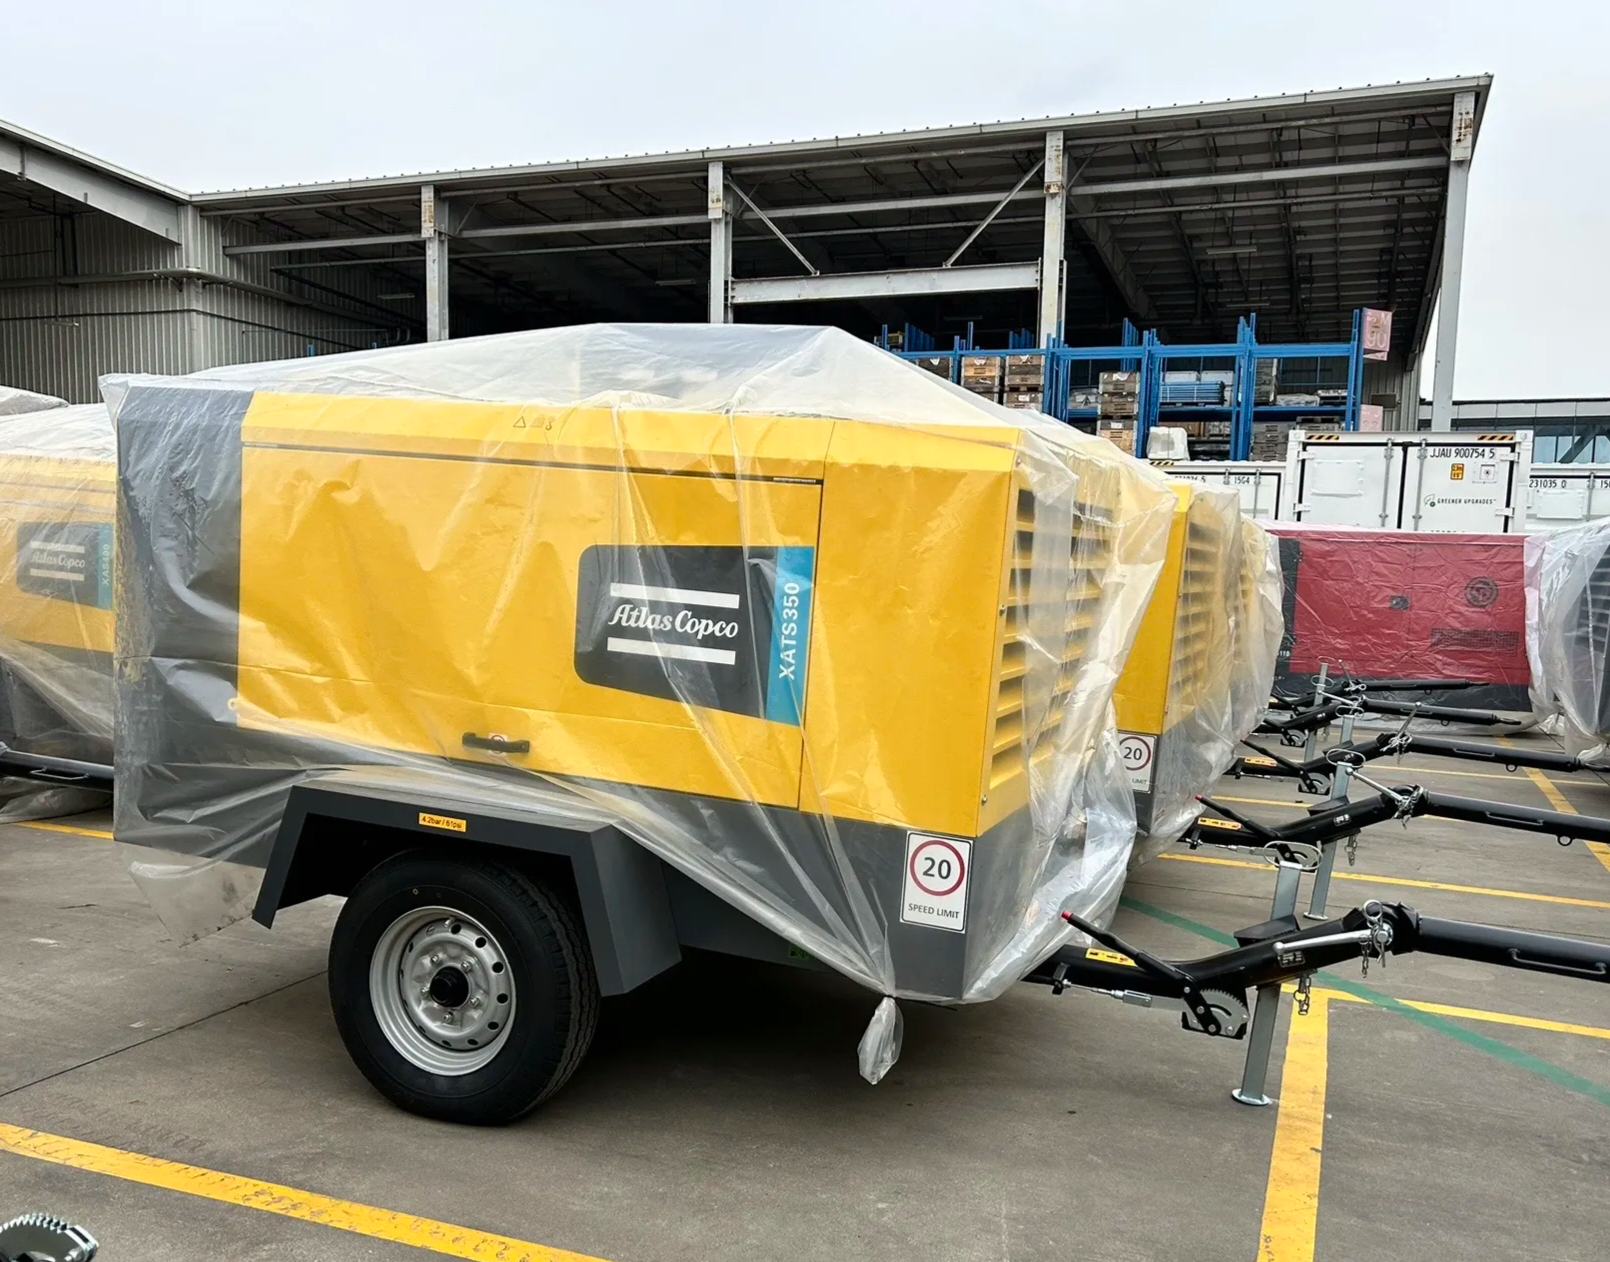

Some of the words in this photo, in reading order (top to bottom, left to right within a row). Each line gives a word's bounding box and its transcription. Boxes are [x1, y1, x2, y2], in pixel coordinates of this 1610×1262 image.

[1430, 448, 1451, 458] JJAU
[1454, 448, 1485, 458] 900754
[1489, 448, 1495, 458] 5
[1529, 479, 1557, 488] 231035
[31, 551, 57, 565] Atlas
[58, 554, 85, 569] Copco
[607, 604, 673, 631] Atlas
[674, 610, 739, 639] Copco
[778, 582, 800, 680] XATS350
[1123, 746, 1143, 761] 20
[922, 856, 952, 880] 20
[908, 903, 935, 915] SPEED
[936, 908, 960, 919] LIMIT
